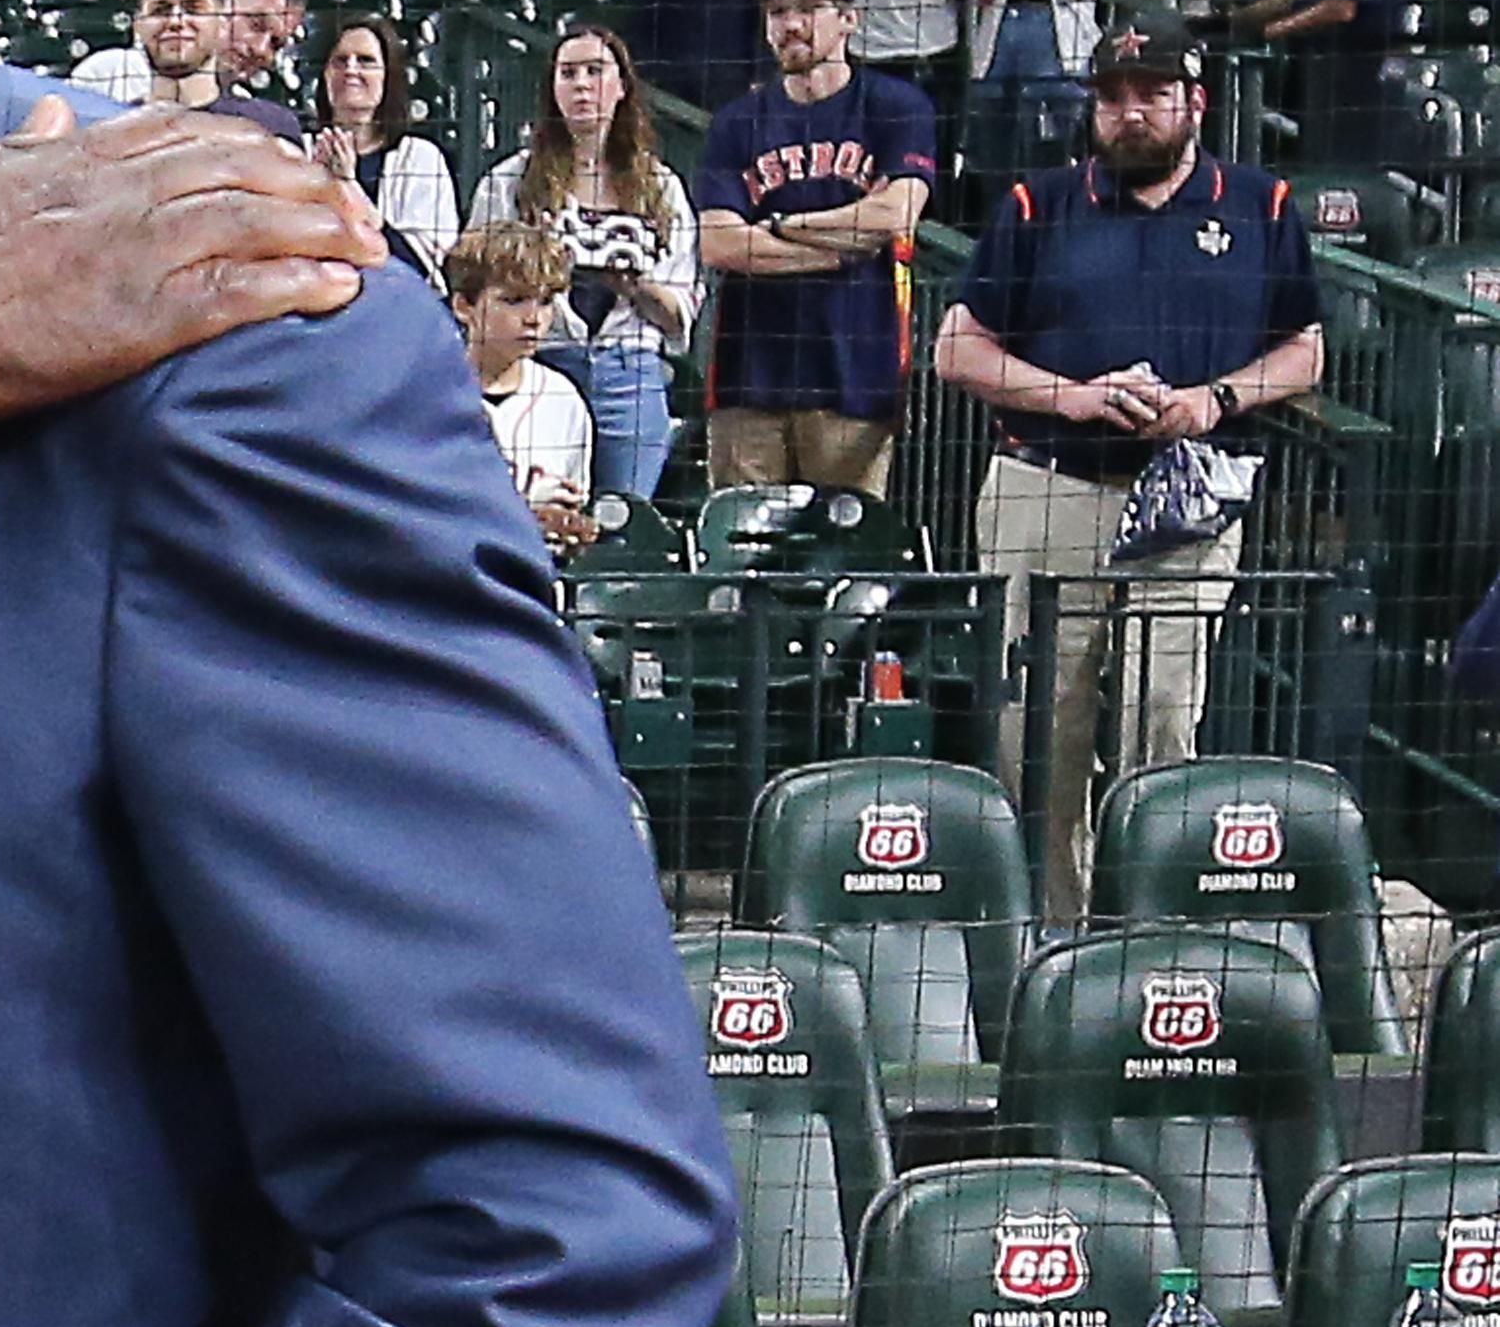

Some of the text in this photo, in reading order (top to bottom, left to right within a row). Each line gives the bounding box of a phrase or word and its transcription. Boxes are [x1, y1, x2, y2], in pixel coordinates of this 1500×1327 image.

[870, 828, 914, 857] 66
[1225, 829, 1269, 857] 66
[724, 1002, 776, 1035] 66
[1155, 1006, 1205, 1037] 66
[766, 1054, 809, 1075] CLUB
[1009, 1249, 1069, 1287] 66
